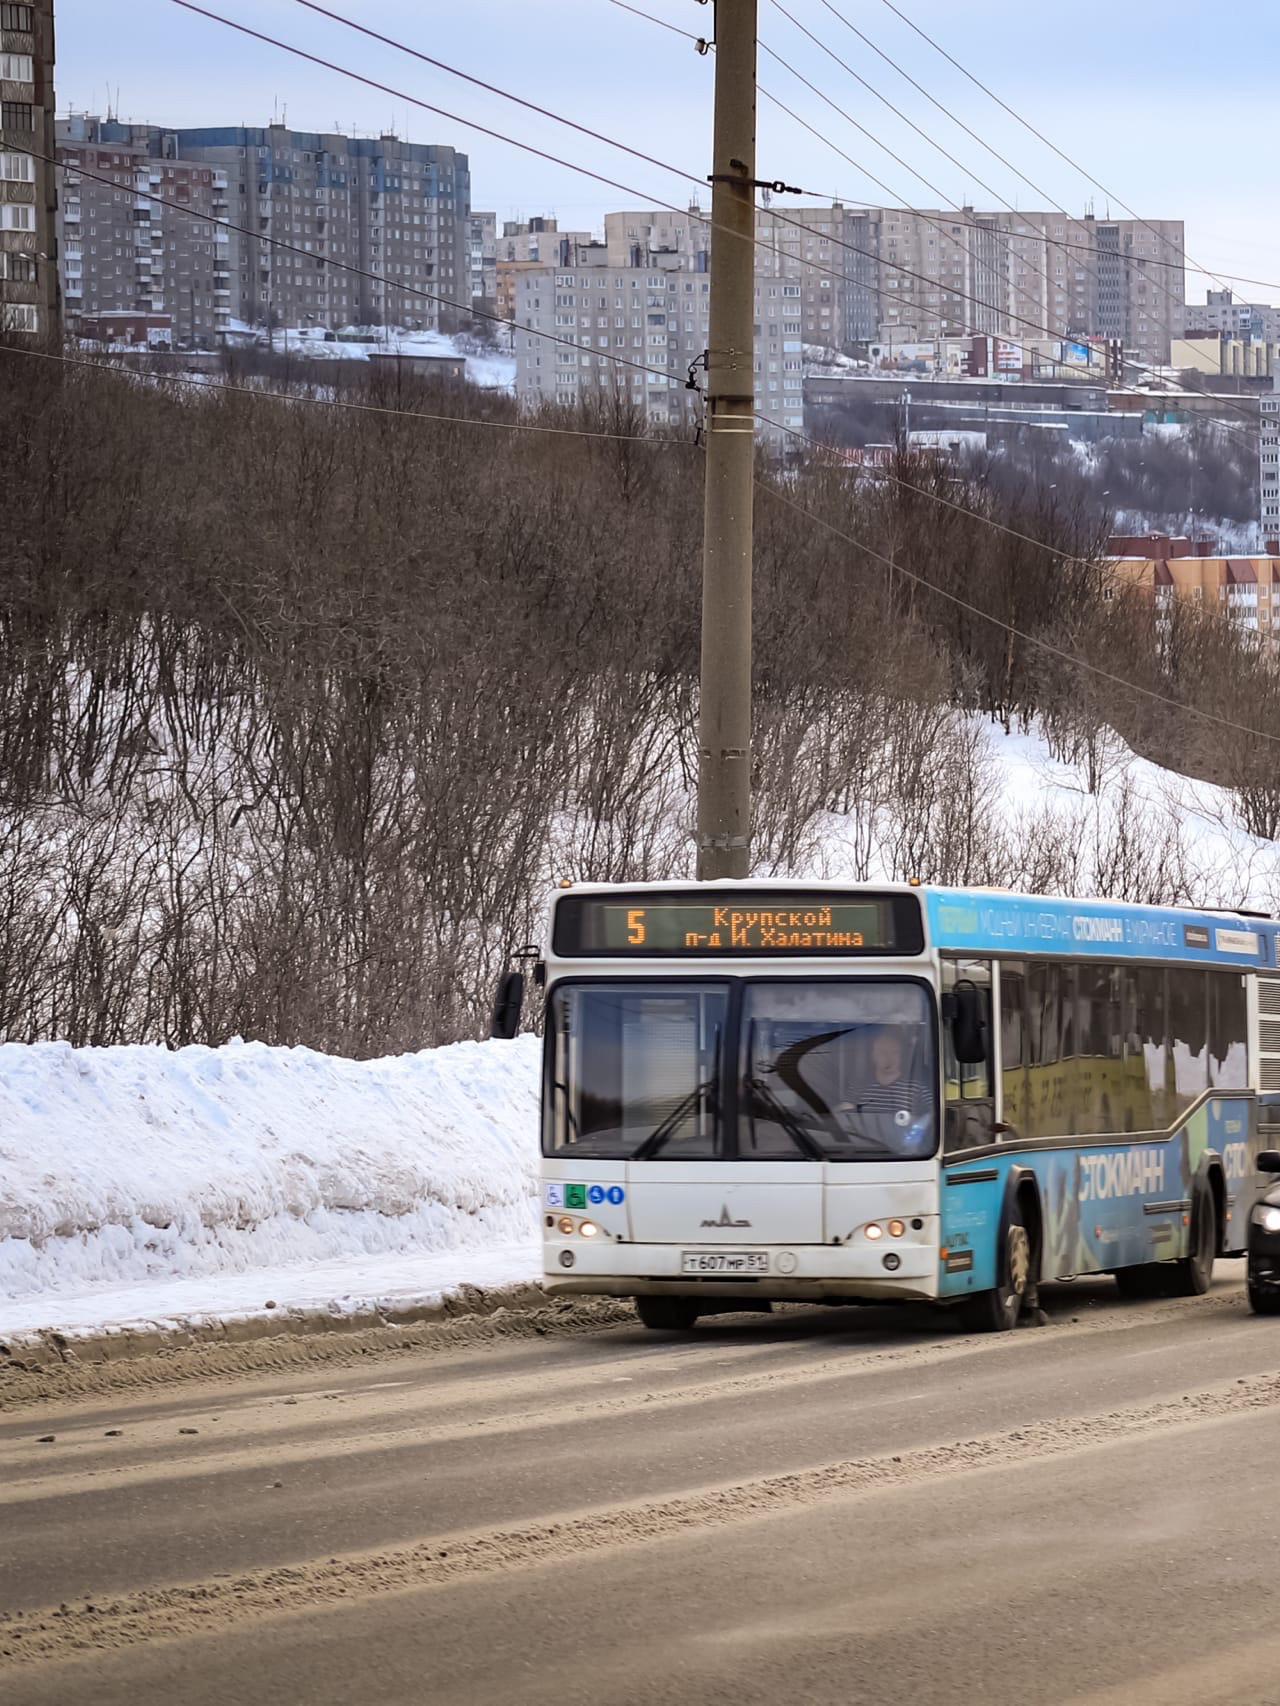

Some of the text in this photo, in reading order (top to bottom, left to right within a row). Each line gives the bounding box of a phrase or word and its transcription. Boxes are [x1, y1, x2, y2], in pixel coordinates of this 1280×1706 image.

[627, 910, 646, 944] 5
[713, 907, 832, 927] Крупской
[1072, 916, 1123, 942] СТОКМАНН
[685, 930, 722, 946] п-д
[760, 929, 864, 946] Халатина
[1079, 1149, 1164, 1201] СТОКМАНН
